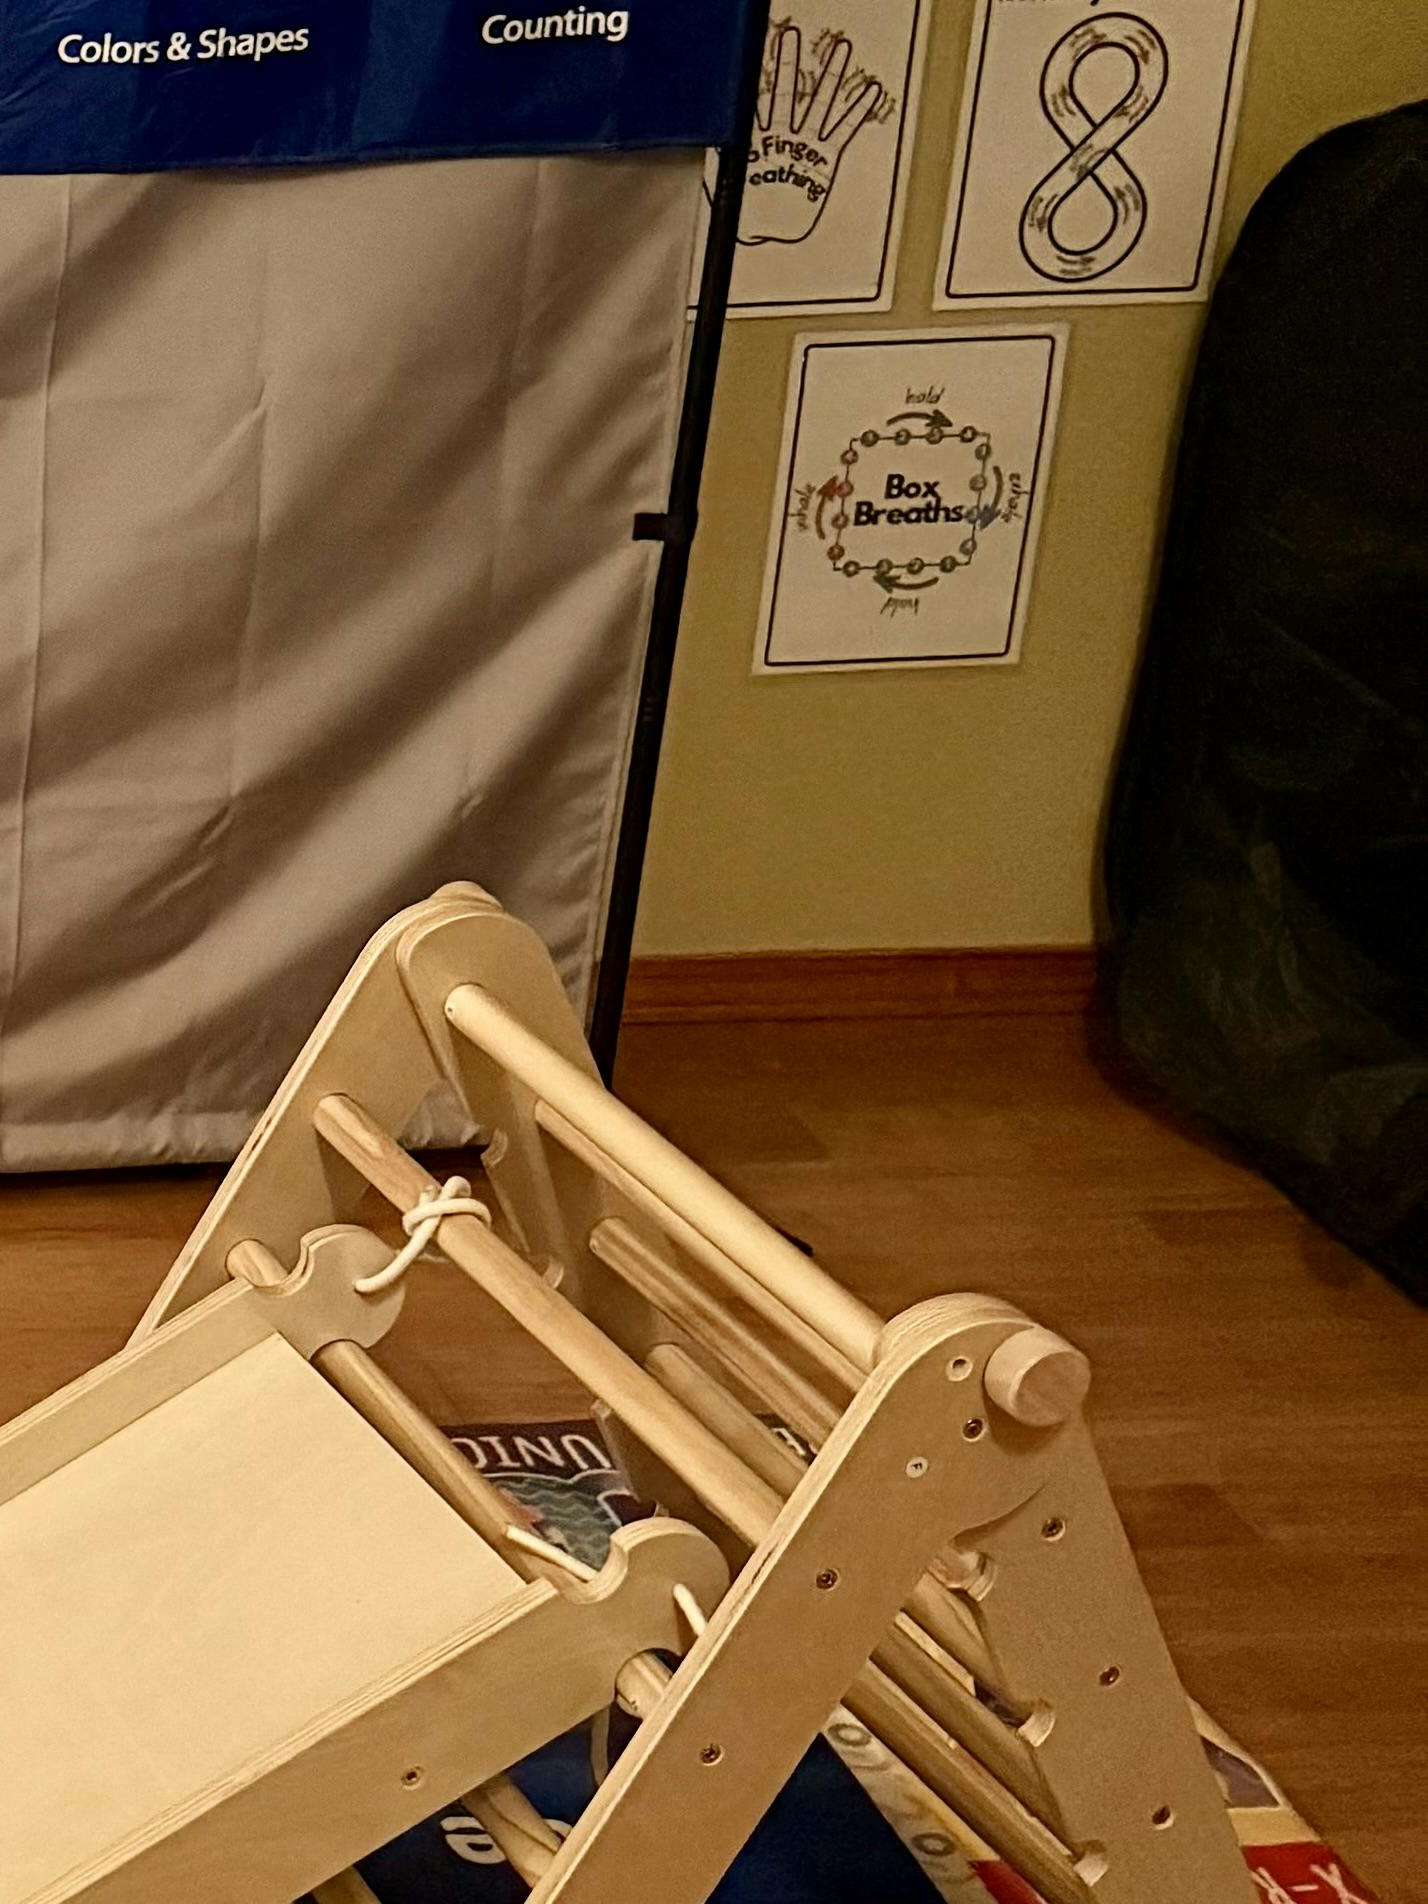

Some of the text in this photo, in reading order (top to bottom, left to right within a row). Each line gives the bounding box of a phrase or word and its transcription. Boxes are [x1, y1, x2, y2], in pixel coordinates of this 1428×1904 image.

[58, 22, 311, 67] Colors & Shapes
[480, 7, 630, 49] Counting
[761, 135, 830, 170] Finger
[748, 164, 827, 204] eathing
[883, 475, 941, 503] Box
[853, 498, 964, 528] Breaths
[454, 1432, 612, 1472] UNIC
